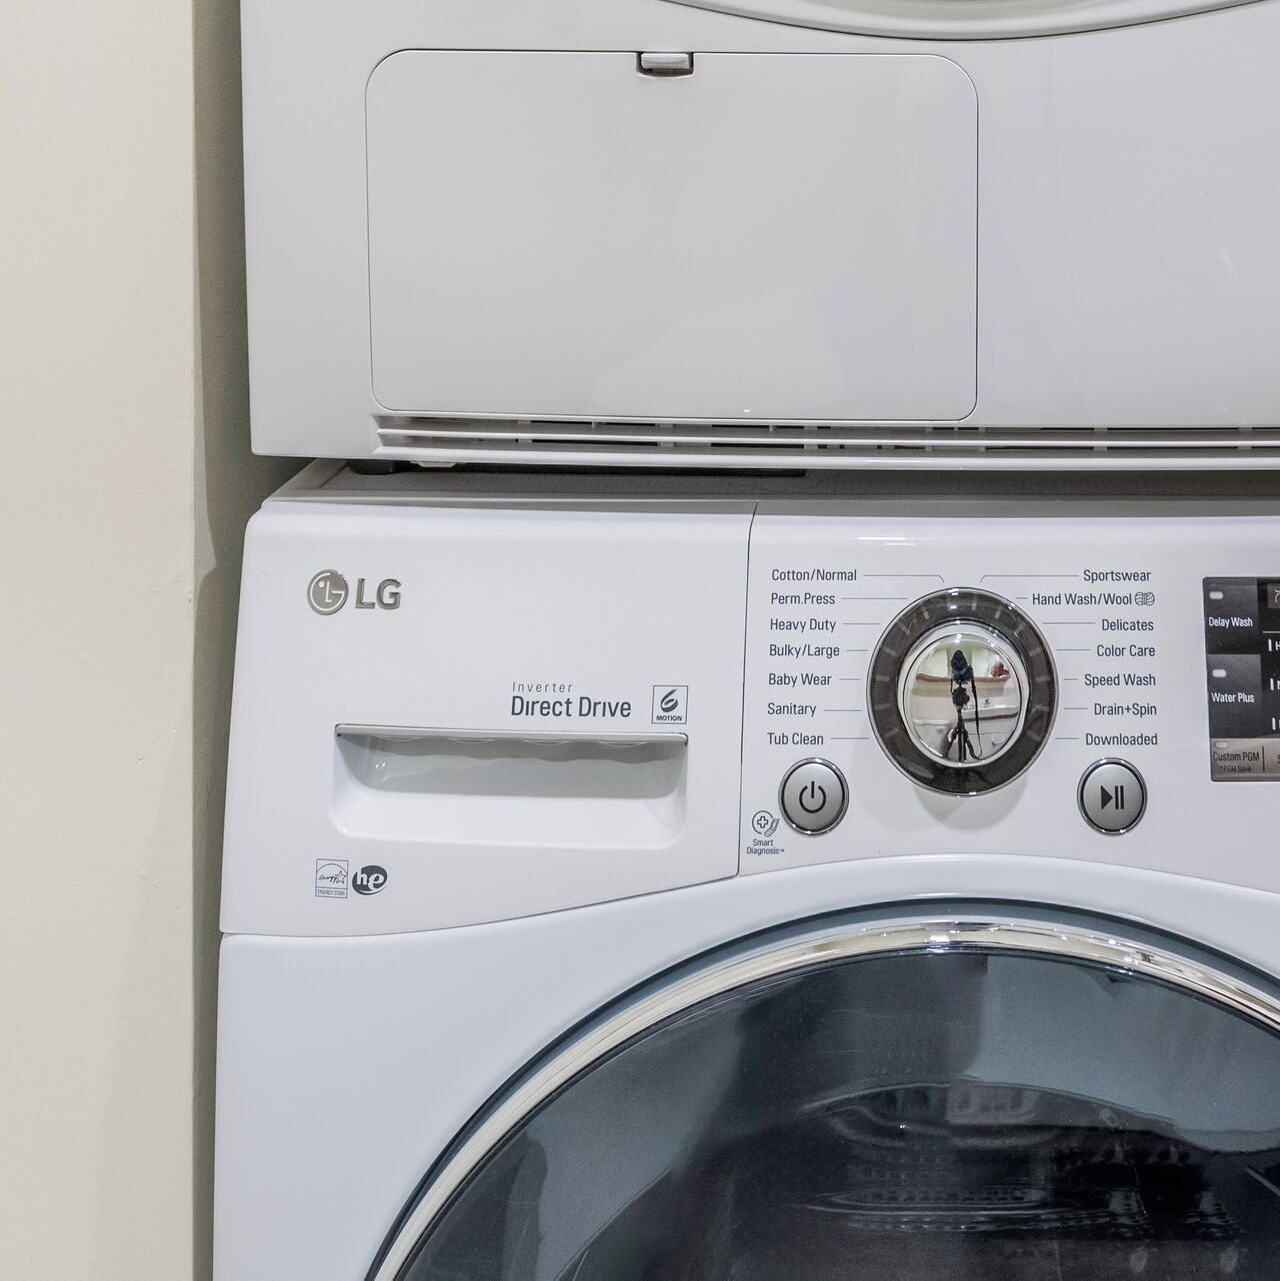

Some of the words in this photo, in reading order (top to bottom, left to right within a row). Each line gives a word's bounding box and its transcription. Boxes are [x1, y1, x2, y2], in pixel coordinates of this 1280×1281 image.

[771, 568, 857, 581] Cotton/Normal
[1083, 569, 1152, 584] Sportswear
[355, 577, 402, 611] LG
[1032, 593, 1062, 605] Hand
[1064, 593, 1132, 605] Wash/Wool
[770, 618, 807, 633] Heavy
[809, 618, 837, 633] Duty
[1101, 618, 1154, 631] Delicates
[1208, 617, 1230, 629] Delay
[1230, 617, 1253, 627] Wash
[769, 644, 840, 659] Bulky/Large
[1096, 644, 1126, 657] Color
[1129, 644, 1156, 657] Care
[768, 672, 798, 688] Baby
[800, 672, 832, 686] Wear
[1084, 673, 1120, 688] Speed
[1123, 673, 1156, 686] Wash
[512, 681, 573, 693] Inverter
[1211, 692, 1236, 702] Water
[1237, 693, 1255, 703] Plus
[511, 695, 572, 717] Direct
[578, 696, 632, 718] Drive
[767, 702, 817, 718] Sanitary
[1094, 702, 1157, 718] Drain+Spin
[767, 732, 789, 745] Tub
[791, 732, 824, 745] Clean
[1085, 732, 1158, 746] Downloaded
[1213, 751, 1242, 762] Custom
[1242, 751, 1260, 762] PGM
[752, 838, 774, 847] Smart
